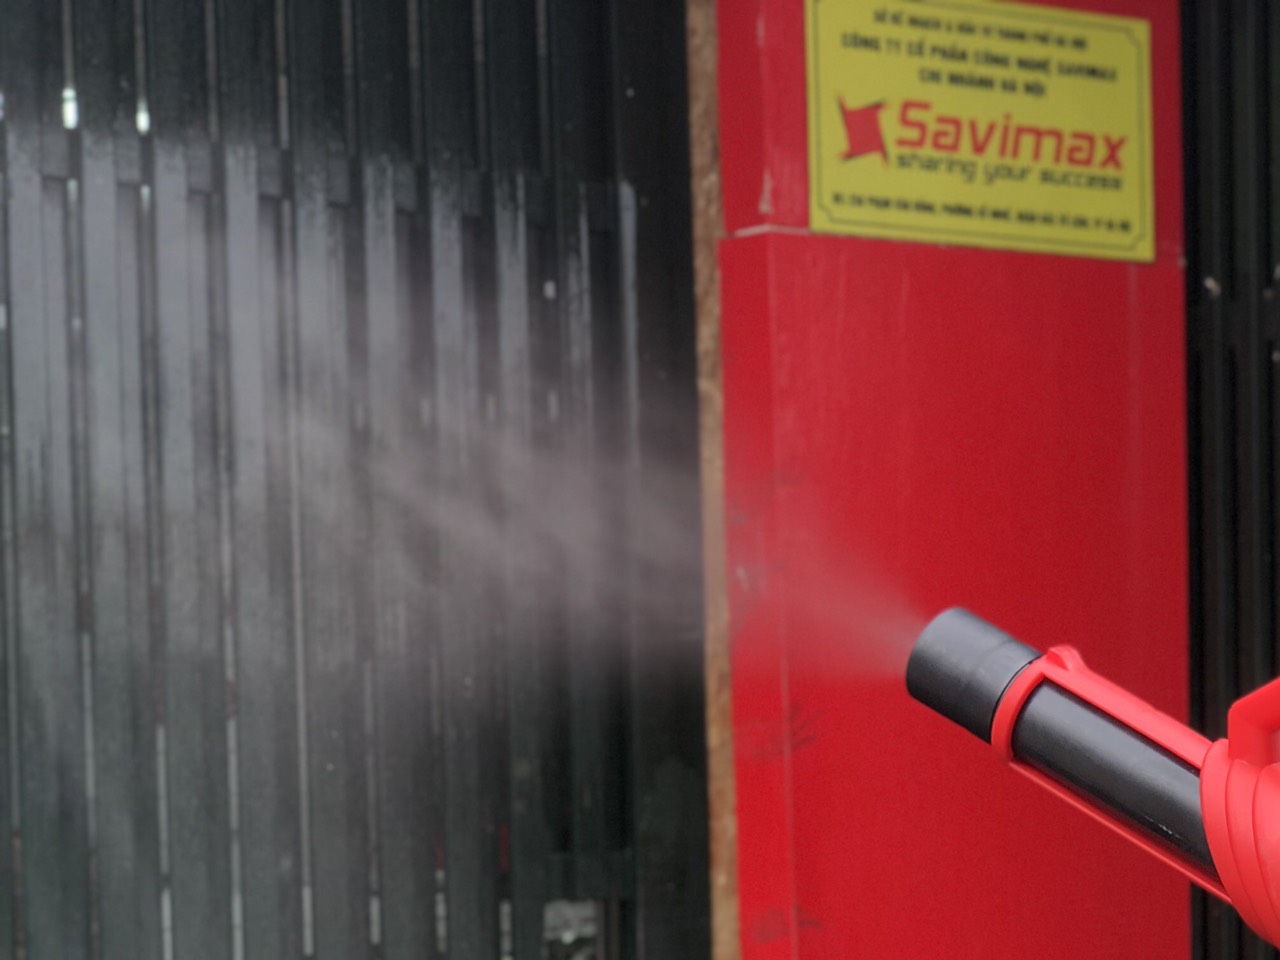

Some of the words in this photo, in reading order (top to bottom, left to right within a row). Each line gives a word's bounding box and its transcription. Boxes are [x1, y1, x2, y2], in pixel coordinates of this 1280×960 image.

[895, 99, 1126, 171] Savimax
[896, 152, 977, 184] sharing
[984, 162, 1031, 186] your
[1040, 168, 1122, 191] success
